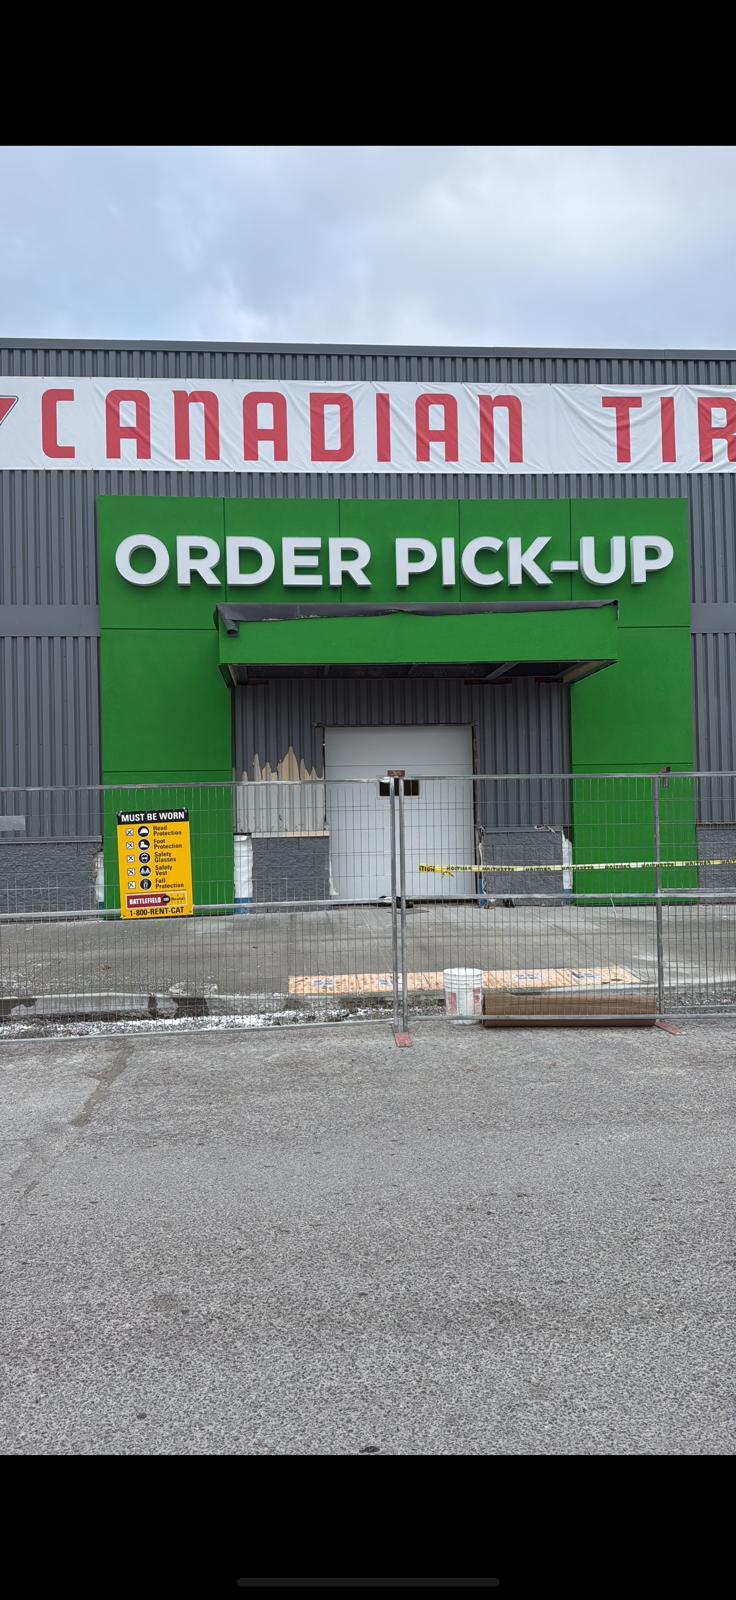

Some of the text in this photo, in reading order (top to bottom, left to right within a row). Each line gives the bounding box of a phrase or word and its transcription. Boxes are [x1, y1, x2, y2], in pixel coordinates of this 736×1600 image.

[42, 388, 524, 463] CANADIAN
[115, 533, 675, 588] ORDER PICK-UP
[121, 811, 185, 822] MUST BE WORN
[129, 896, 162, 905] BATTLEFIELD
[130, 906, 185, 917] 1-800-RENT-CAT
